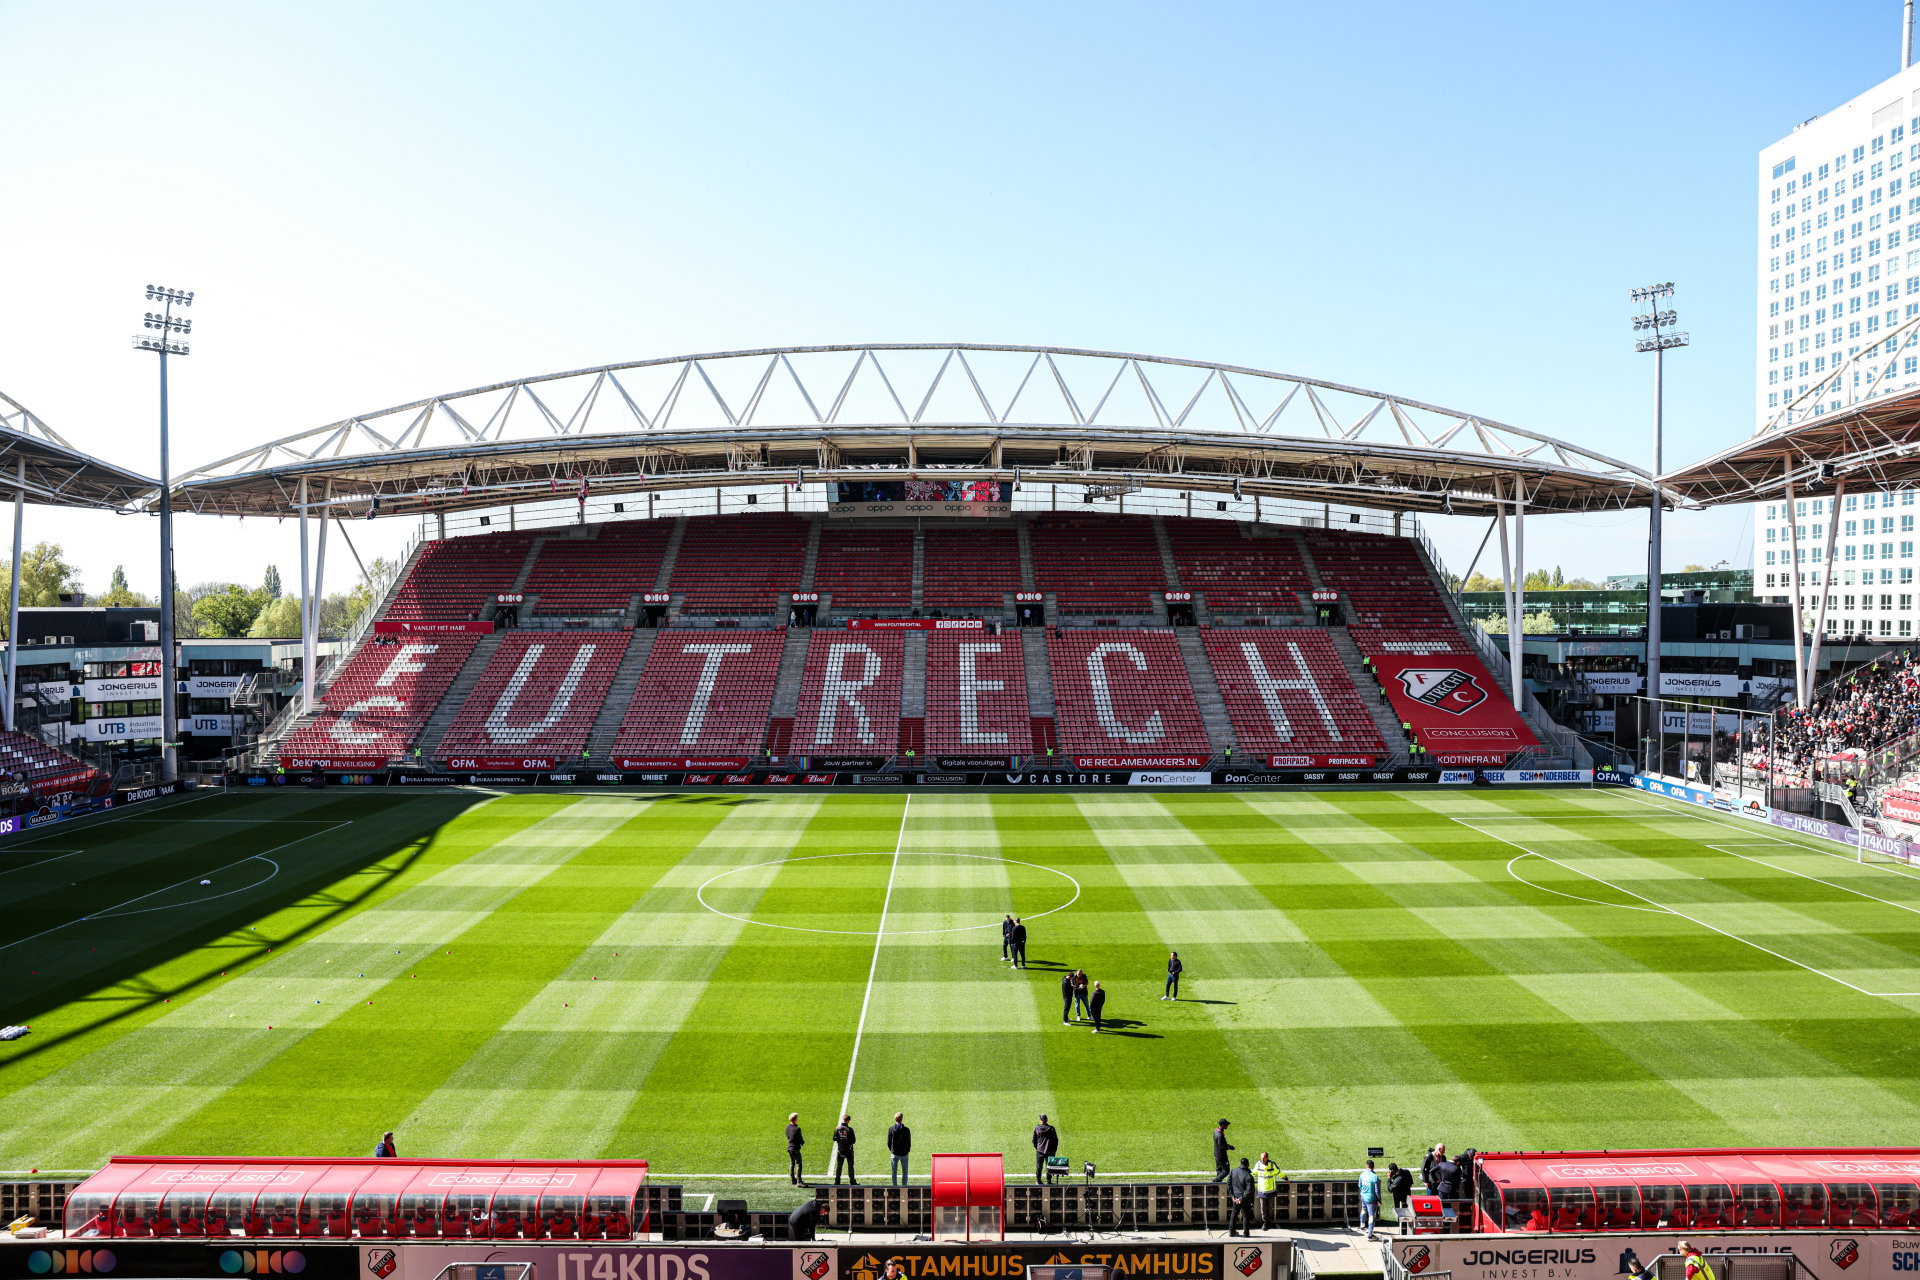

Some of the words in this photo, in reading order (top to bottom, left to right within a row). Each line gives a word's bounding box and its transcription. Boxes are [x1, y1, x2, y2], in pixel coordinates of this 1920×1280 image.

[97, 682, 158, 691] JONGERIUS
[1420, 672, 1468, 705] UTRECHT
[1665, 679, 1722, 687] JONGERIUS
[98, 722, 126, 735] UTB
[195, 719, 218, 730] UTB
[332, 760, 376, 768] BEVEILIGING
[842, 760, 864, 768] partner
[942, 758, 966, 767] digitale
[966, 759, 1005, 767] vooruitgang
[1079, 758, 1093, 766] DE
[1094, 758, 1201, 766] RECLAMEMAKERS.NL
[1274, 757, 1309, 765] PROFIPACK
[1437, 755, 1503, 764] KOOTINFRA.NL
[689, 774, 709, 783] Bud
[726, 774, 746, 783] Bud
[769, 774, 788, 783] Bud
[807, 774, 827, 783] Bud
[1029, 774, 1111, 784] CASTORE
[127, 788, 156, 802] DeKroon
[1794, 817, 1828, 836] IT4KIDS
[1861, 833, 1900, 855] IT4KIDS
[1561, 1165, 1684, 1176] CONCLUSION
[167, 1173, 290, 1182] CONCLUSION
[442, 1175, 565, 1186] CONCLUSION
[1463, 1248, 1596, 1266] JONGERIUS
[1833, 1240, 1858, 1263] UTRECHT
[372, 1250, 395, 1273] UTRECHT
[1237, 1248, 1262, 1271] UTRECHT
[1406, 1246, 1428, 1269] UTRECHT
[557, 1253, 711, 1280] IT4KIDS
[804, 1252, 828, 1276] UTRECHT
[1482, 1269, 1538, 1279] INVEST
[1548, 1268, 1577, 1278] B.V.
